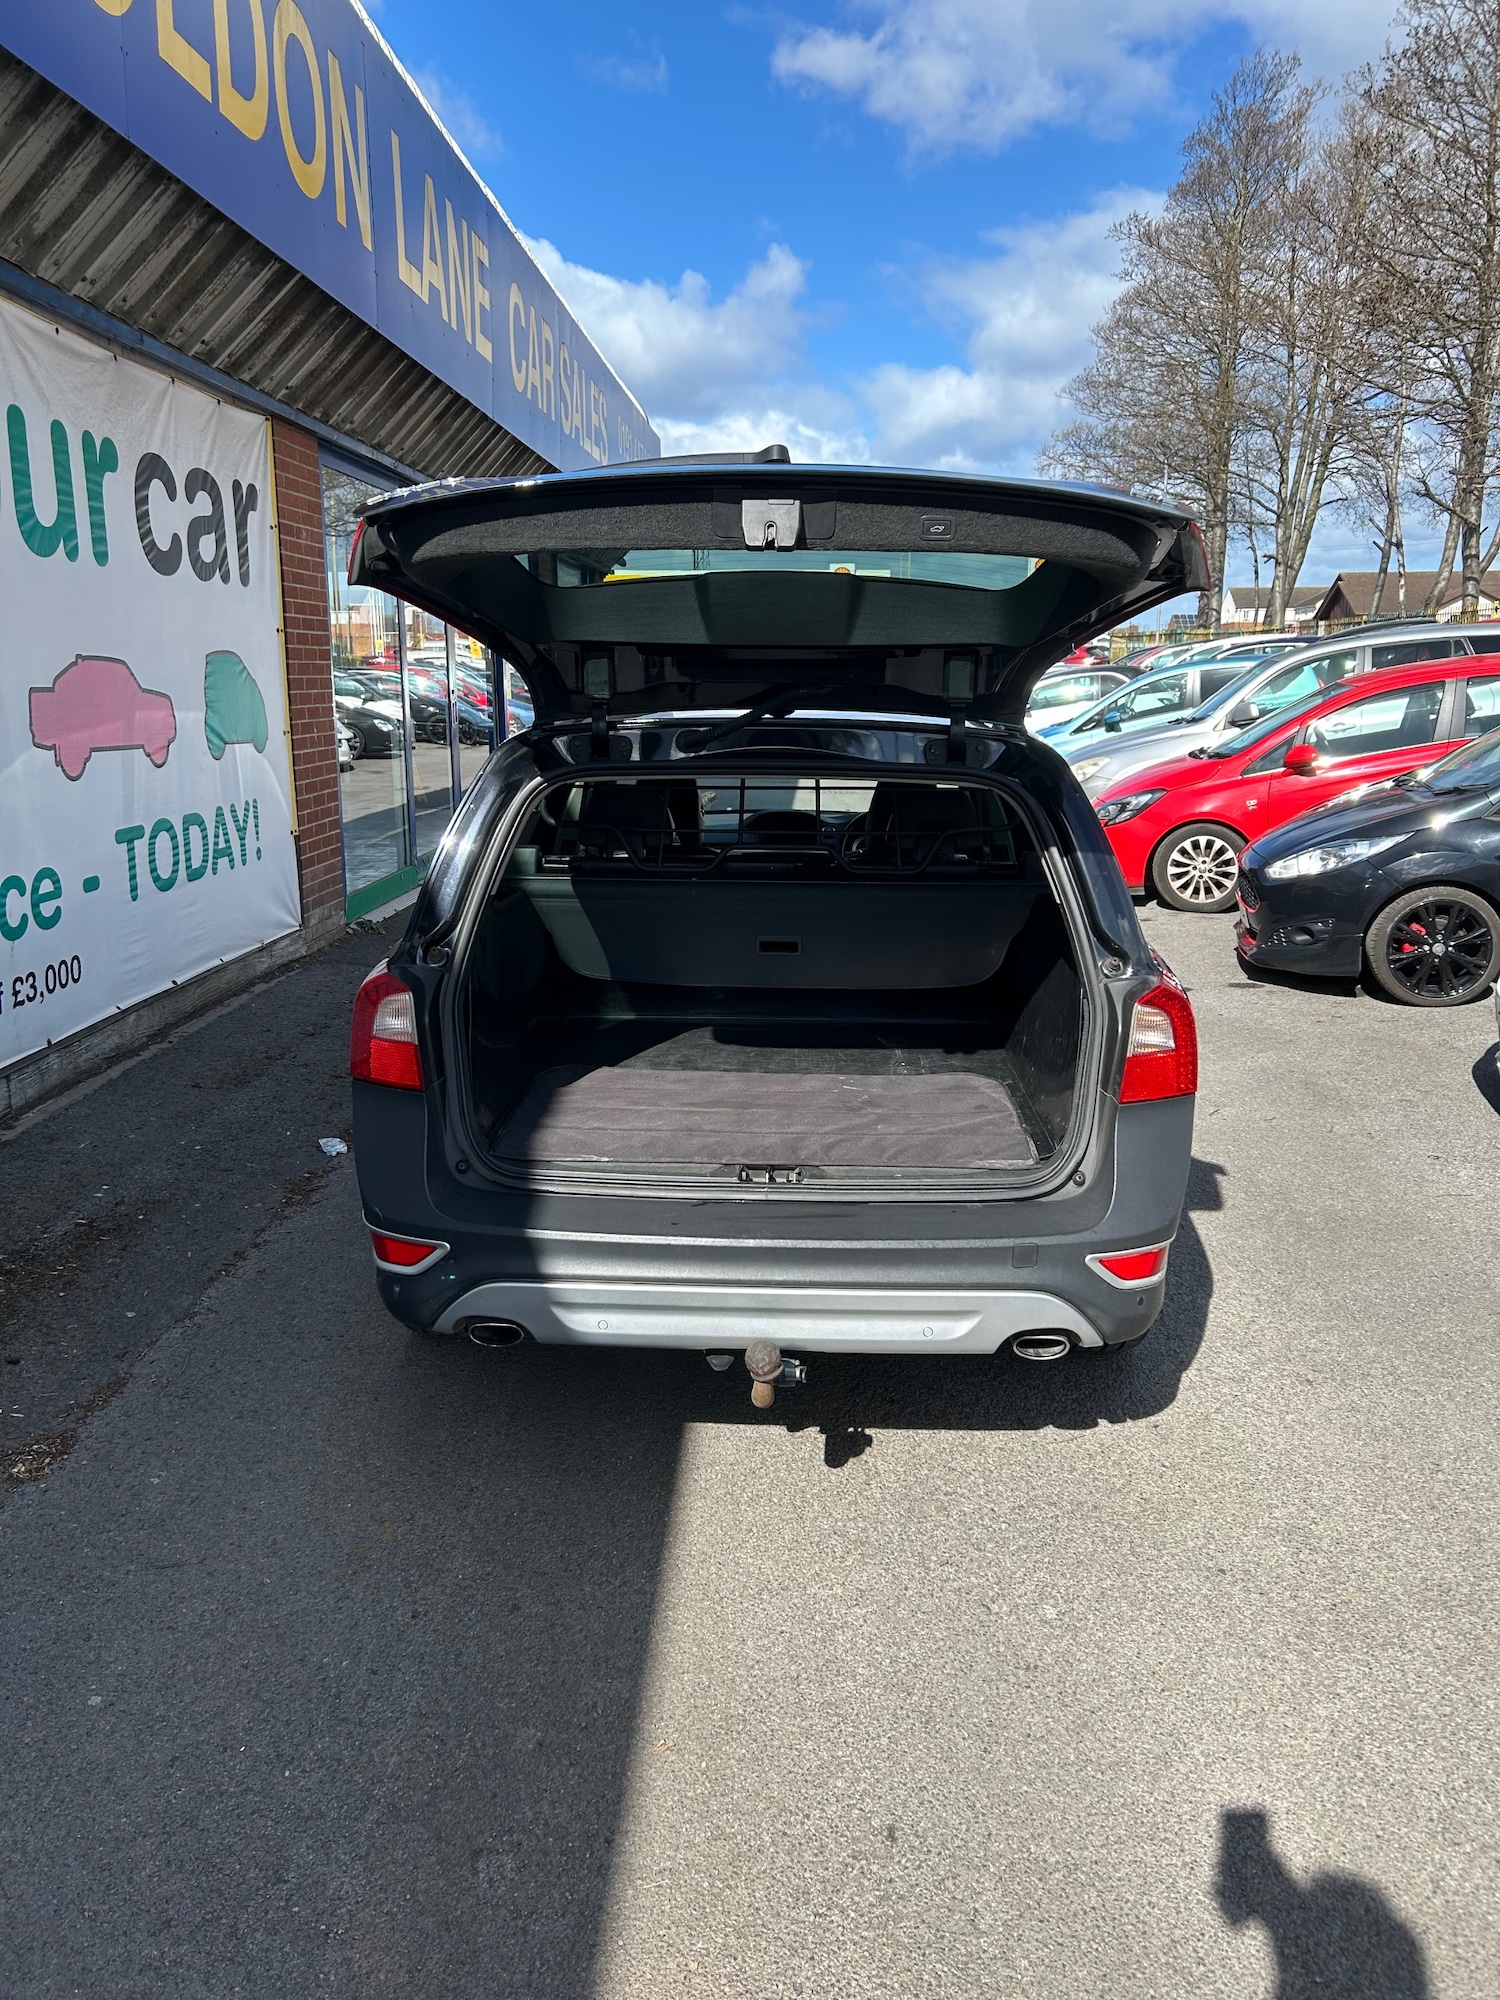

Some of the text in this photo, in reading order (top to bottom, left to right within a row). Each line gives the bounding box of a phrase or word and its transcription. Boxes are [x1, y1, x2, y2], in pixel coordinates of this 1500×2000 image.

[390, 129, 493, 364] LANE
[509, 282, 556, 422] CAR
[559, 343, 609, 466] SALES
[6, 403, 258, 588] ur car
[0, 866, 63, 941] ce
[114, 798, 263, 902] TODAY!
[12, 954, 82, 1010] £3,000
